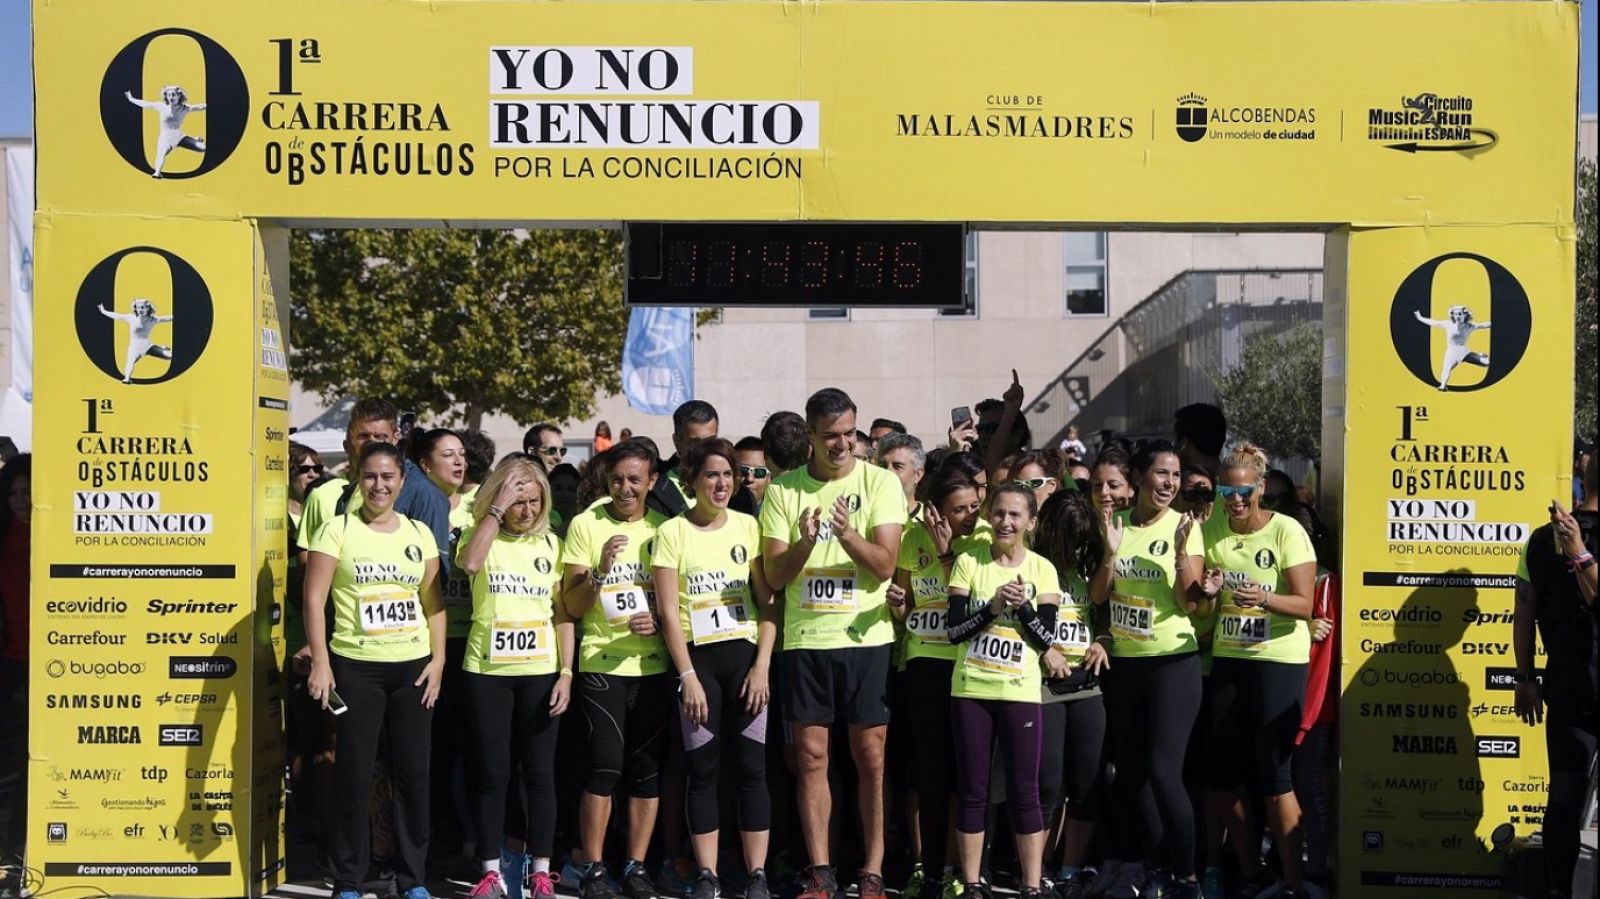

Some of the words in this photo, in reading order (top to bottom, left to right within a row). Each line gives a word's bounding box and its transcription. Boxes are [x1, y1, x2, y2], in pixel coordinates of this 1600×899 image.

[492, 48, 574, 90] YO
[594, 48, 679, 90] NO
[986, 95, 1020, 105] CLUB
[1027, 95, 1043, 105] DE
[262, 101, 451, 131] CARRERA
[1210, 107, 1316, 123] ALCOBENDAS
[1368, 108, 1420, 126] Music
[1436, 108, 1472, 126] Run
[493, 103, 803, 145] RENUNCIO
[896, 113, 1134, 139] MALASMADRES
[288, 136, 305, 150] de
[1209, 130, 1219, 140] Un
[1221, 130, 1262, 140] modelo
[1263, 130, 1278, 140] de
[1279, 130, 1316, 140] ciudad
[265, 136, 474, 185] OBSTÁCULOS
[495, 157, 552, 178] POR
[563, 157, 595, 178] LA
[602, 152, 802, 179] CONCILIACIÓN
[77, 437, 193, 455] CARRERA
[1391, 444, 1509, 463] CARRERA
[78, 457, 209, 488] OBSTÁCULOS
[1392, 465, 1525, 496] OBSTÁCULOS
[76, 492, 110, 510] YO
[119, 492, 154, 510] NO
[1389, 500, 1424, 518] YO
[1434, 500, 1469, 518] NO
[76, 514, 207, 532] RENUNCIO
[75, 536, 100, 546] POR
[104, 536, 118, 546] LA
[121, 534, 206, 547] CONCILIACIÓN
[1389, 522, 1522, 542] RENUNCIO
[1389, 544, 1414, 554] POR
[1419, 544, 1432, 554] LA
[1435, 543, 1522, 556] CONCILIACIÓN
[355, 564, 374, 575] YO
[378, 563, 397, 573] NO
[1120, 558, 1136, 567] NO
[82, 566, 203, 578] #carrerayonorenuncio
[355, 575, 420, 585] RENUNCIO
[489, 573, 506, 583] YO
[509, 574, 526, 583] NO
[687, 574, 704, 585] YO
[708, 570, 725, 581] NO
[1115, 569, 1160, 579] NUNCIO
[488, 584, 549, 596] RENUNCIO
[689, 579, 747, 595] RENUNCIO
[807, 579, 836, 599] 100
[46, 597, 128, 613] ecovidrio
[147, 599, 238, 616] Sprinter
[616, 592, 638, 611] 58
[365, 601, 407, 624] 1143
[711, 609, 720, 629] 1
[909, 611, 950, 631] 5101
[1112, 603, 1138, 628] 1075
[1360, 605, 1442, 621] ecovidrio
[1221, 616, 1252, 637] 1074
[47, 631, 127, 645] Carrefour
[146, 632, 193, 644] DKV
[199, 632, 238, 644] Salud
[495, 630, 537, 651] 5102
[972, 634, 1011, 660] 1100
[1361, 639, 1441, 655] Carrefour
[1462, 643, 1509, 655] DKV
[46, 694, 142, 709] SAMSUNG
[174, 693, 217, 704] CEPSA
[1360, 702, 1457, 719] SAMSUNG
[77, 726, 142, 744] MARCA
[1392, 735, 1458, 755] MARCA
[141, 766, 168, 783] tdp
[185, 768, 235, 779] Cazorla
[1457, 778, 1485, 794] tdp
[124, 823, 145, 837] efr
[77, 864, 198, 876] #carrerayonorenuncio
[1394, 874, 1500, 887] #carrerayonorenun
